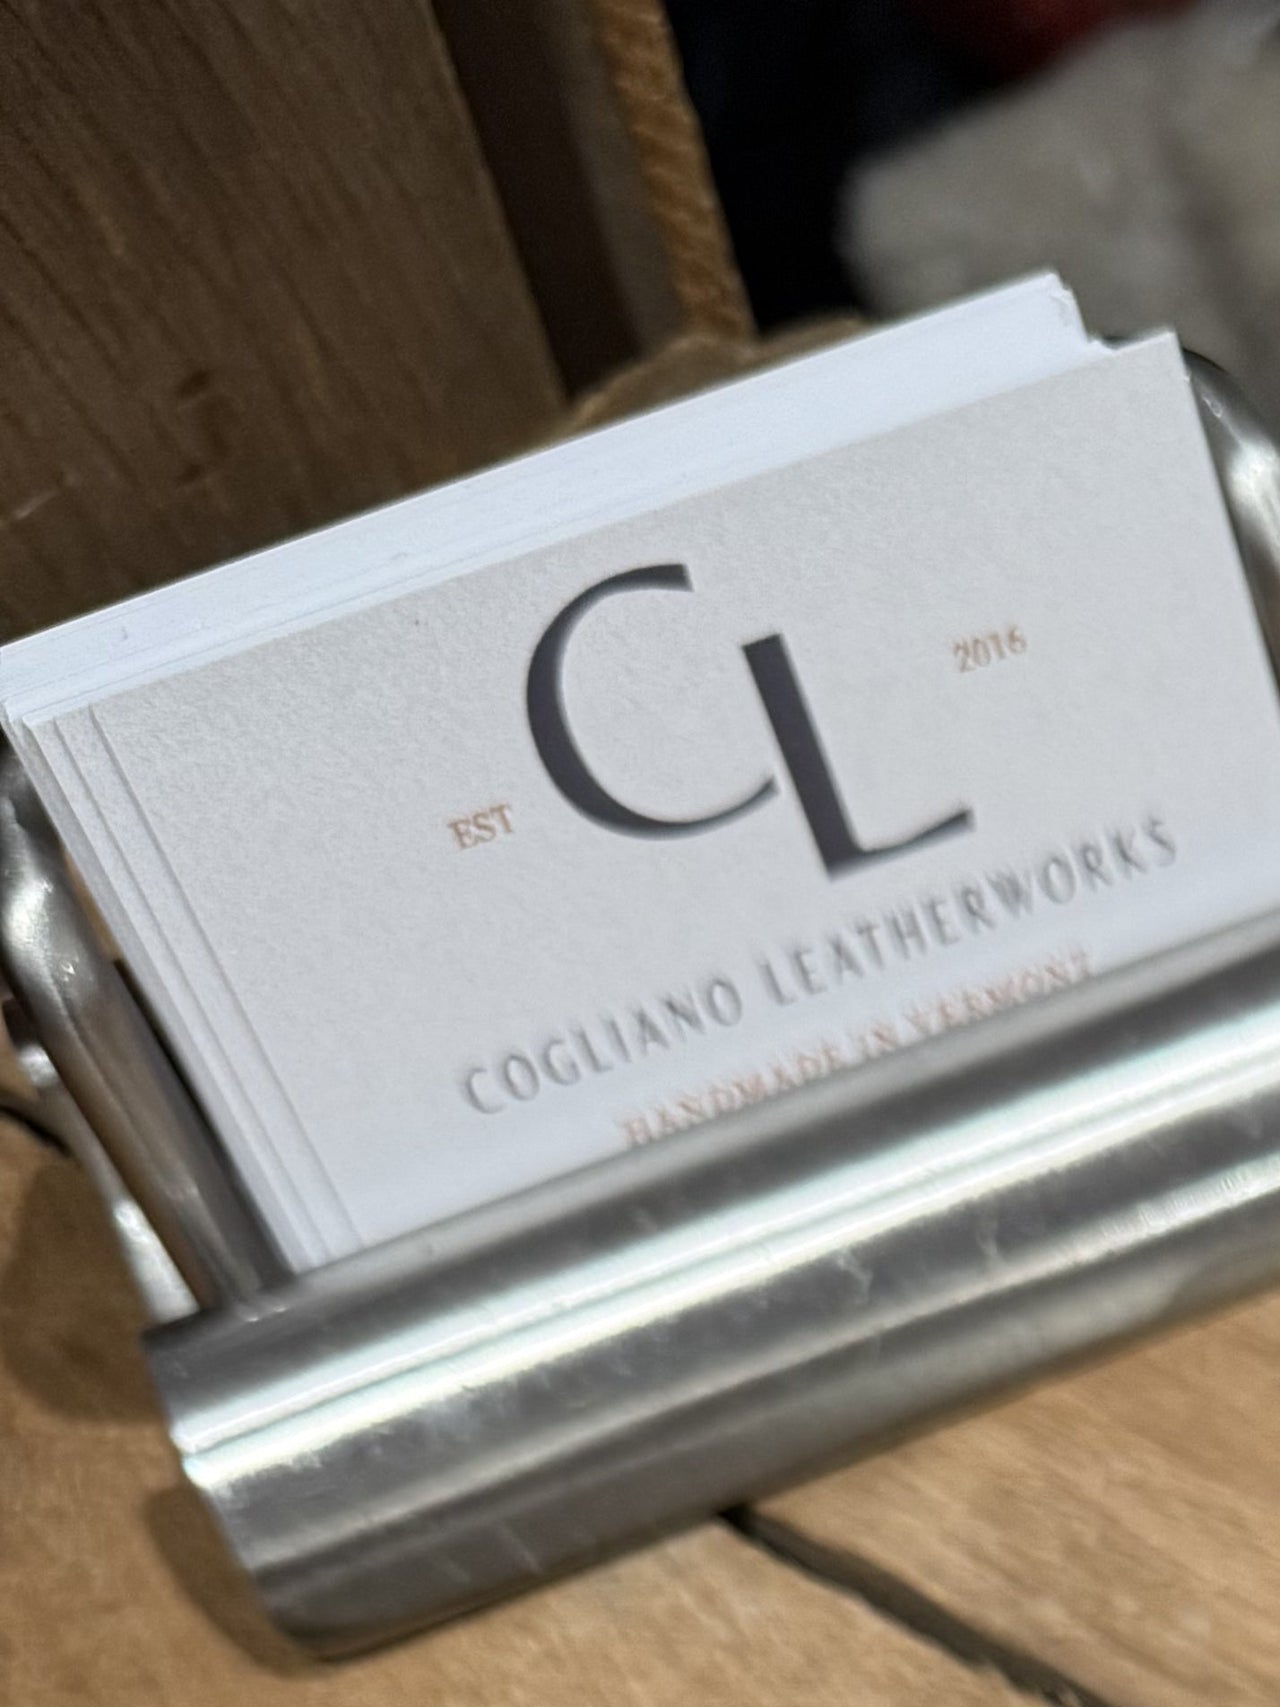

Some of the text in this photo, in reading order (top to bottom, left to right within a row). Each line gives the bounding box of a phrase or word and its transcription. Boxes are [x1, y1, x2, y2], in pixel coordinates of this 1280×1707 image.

[950, 624, 1029, 675] 2016
[448, 803, 514, 850] EST
[460, 812, 1176, 1116] COGLIANO LEATHERWORKS
[619, 948, 1098, 1149] HANDMADE IN VERMONT
